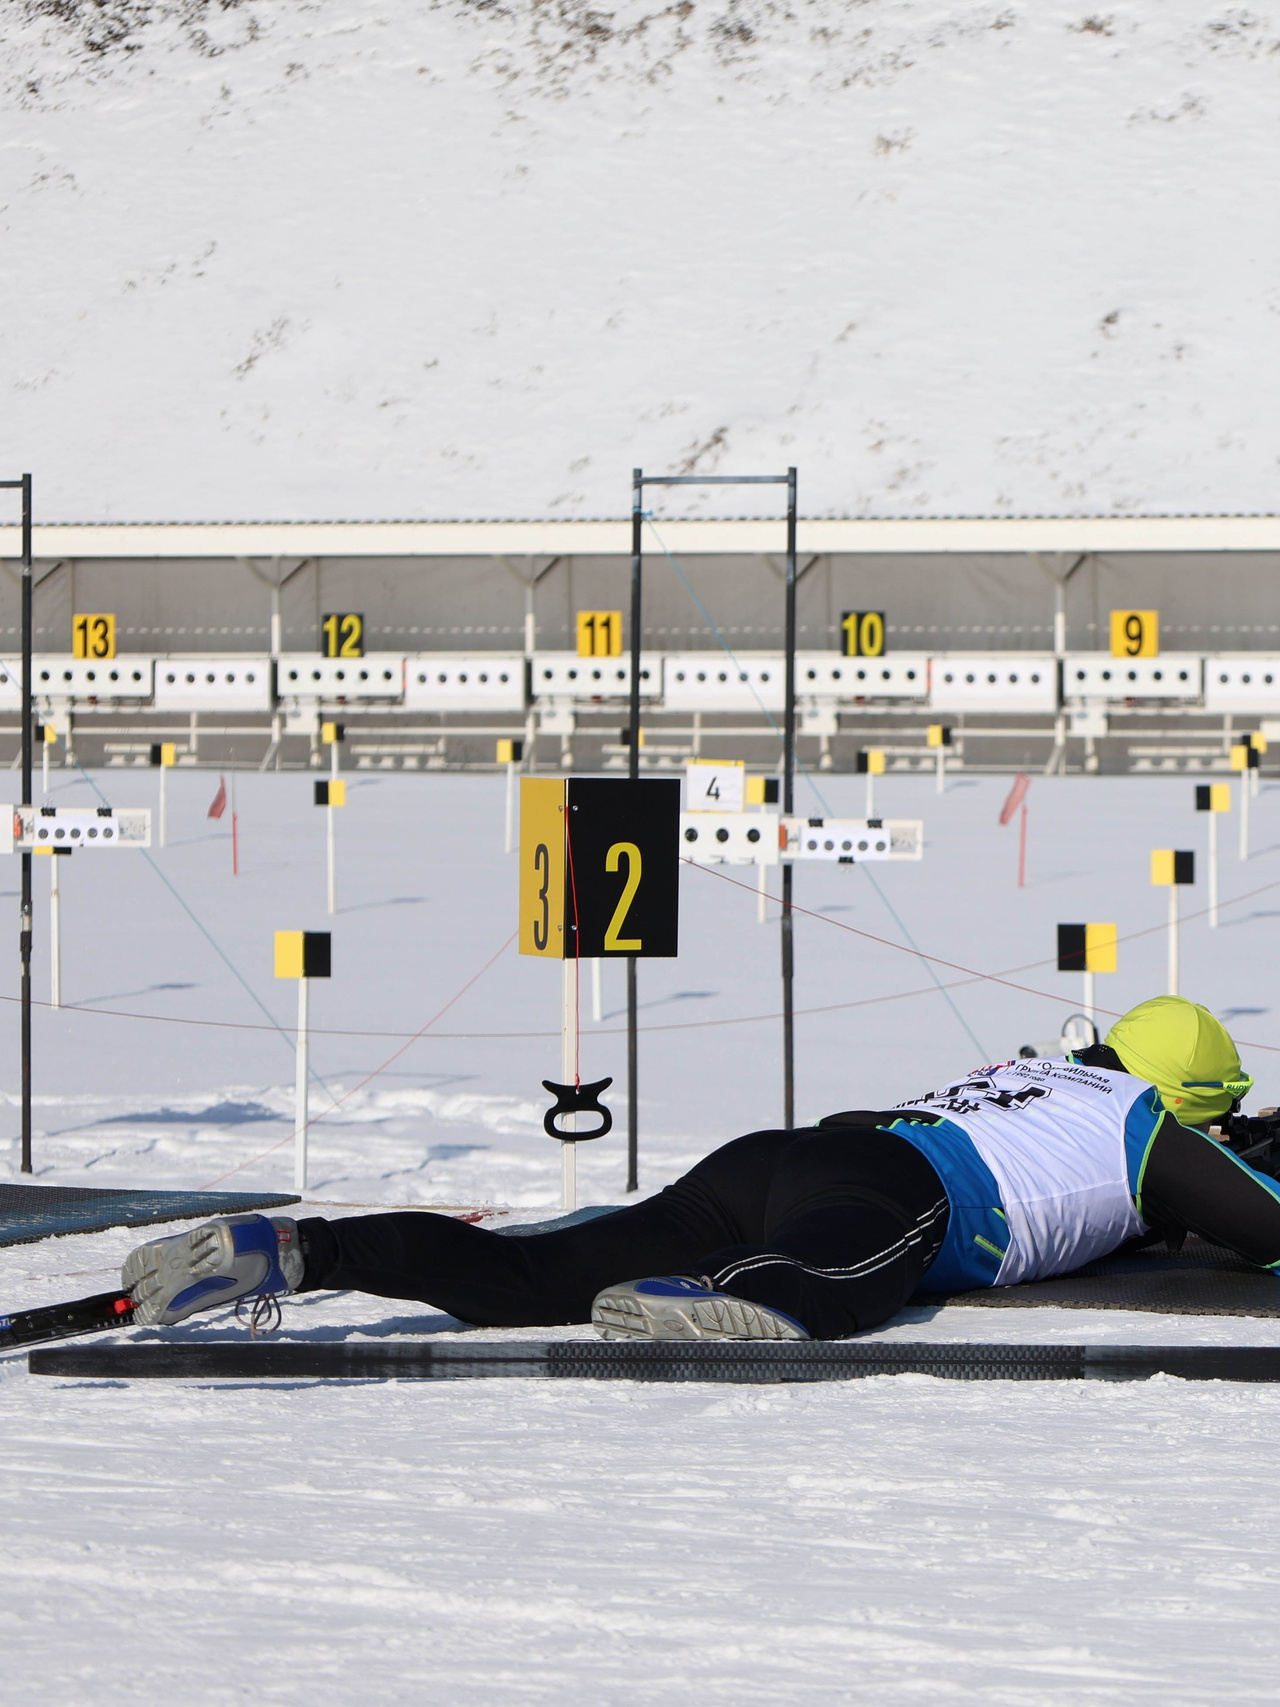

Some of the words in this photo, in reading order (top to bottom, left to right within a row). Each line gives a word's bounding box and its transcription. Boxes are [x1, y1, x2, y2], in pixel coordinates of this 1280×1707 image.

[78, 618, 109, 658] 13
[323, 614, 362, 659] 12
[584, 616, 611, 655] 11
[842, 612, 884, 656] 10
[1125, 615, 1144, 657] 9
[705, 777, 720, 800] 4
[533, 843, 549, 951] 3
[604, 842, 642, 951] 2
[1051, 1072, 1113, 1095] КОМПАНИЙ
